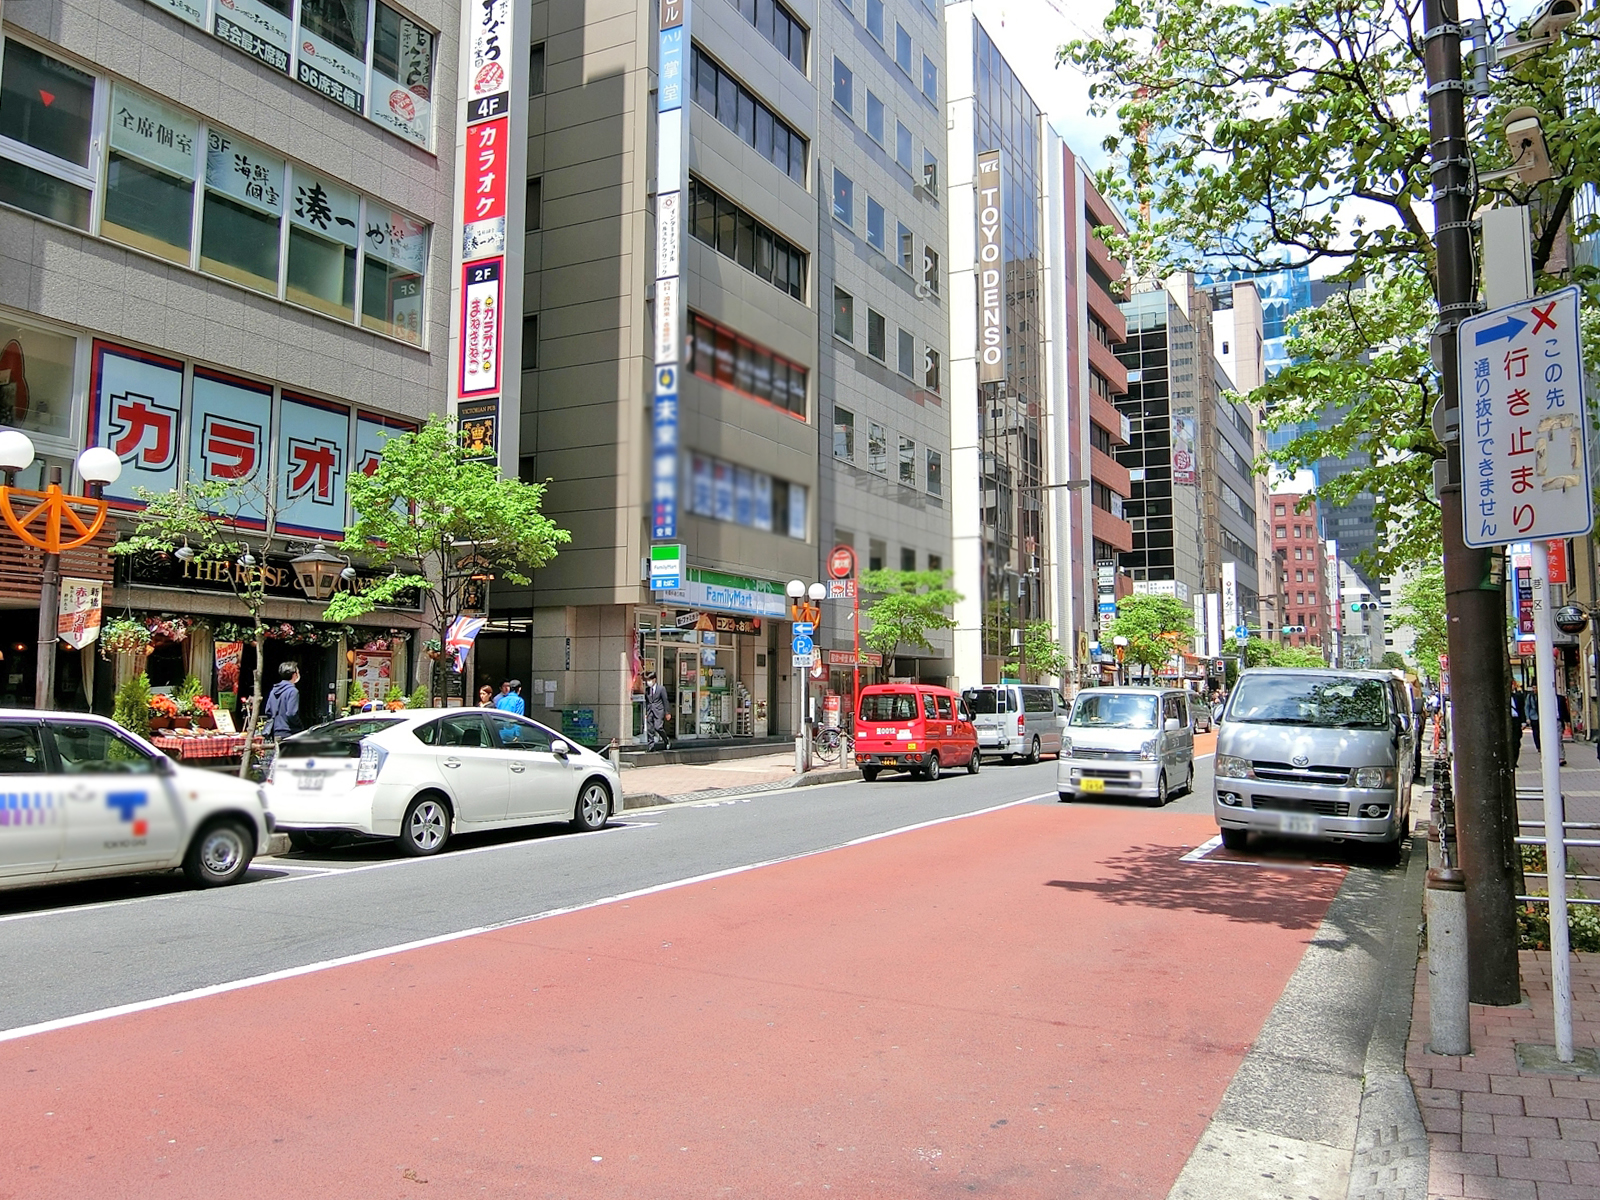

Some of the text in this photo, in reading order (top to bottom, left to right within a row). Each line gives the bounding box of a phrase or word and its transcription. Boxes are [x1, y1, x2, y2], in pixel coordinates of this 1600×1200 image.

[665, 0, 679, 22] ル
[217, 19, 288, 72] 宴会最大席数
[299, 64, 362, 112] 96席完備!
[478, 98, 499, 117] 4F
[116, 106, 193, 157] 全席個室
[209, 131, 231, 153] 3F
[234, 153, 270, 186] 海鮮
[245, 181, 280, 207] 個室
[476, 127, 496, 217] カラオケ
[475, 268, 492, 282] 2F
[981, 188, 1002, 365] TOYO DENSO
[469, 298, 481, 375] まねきねこ
[483, 307, 495, 361] カラオケ
[1544, 338, 1566, 411] この先
[461, 404, 496, 415] VICTORIAN PUB
[1473, 357, 1498, 538] 通り抜けできません
[1503, 347, 1536, 534] 行き止まり
[181, 558, 229, 583] THE
[235, 563, 290, 588] ROSE
[706, 585, 753, 608] FamilyMart
[72, 586, 87, 643] 赤レンガ通り
